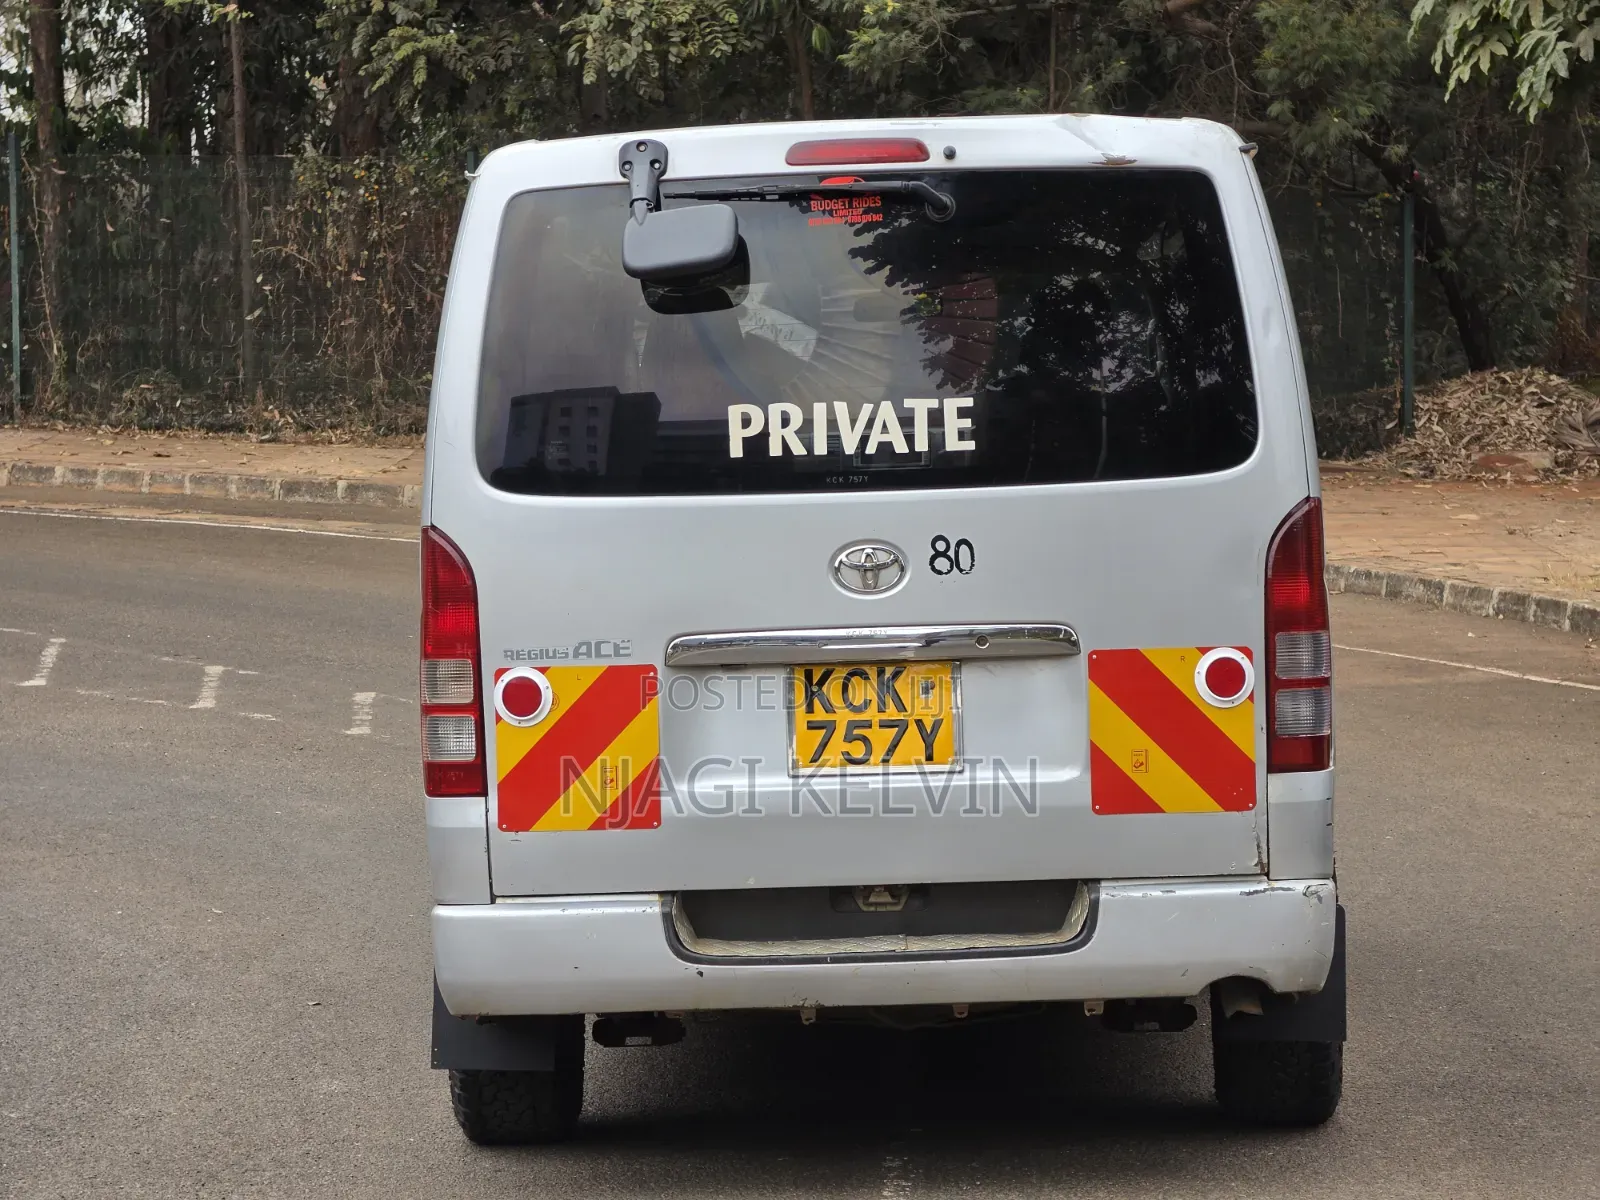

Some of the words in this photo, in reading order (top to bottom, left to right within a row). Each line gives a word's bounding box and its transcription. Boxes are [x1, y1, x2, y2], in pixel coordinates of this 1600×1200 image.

[810, 199, 849, 211] BUDGET
[852, 196, 882, 208] RIDES
[833, 208, 863, 217] LIMITED
[728, 397, 976, 458] PRIVATE
[826, 476, 844, 484] KCK
[849, 475, 869, 483] 757Y
[928, 534, 976, 575] 80
[503, 647, 570, 661] REGIUS
[573, 640, 632, 659] ACE
[1180, 655, 1186, 663] R
[803, 666, 908, 715] KCK
[806, 718, 944, 766] 757Y
